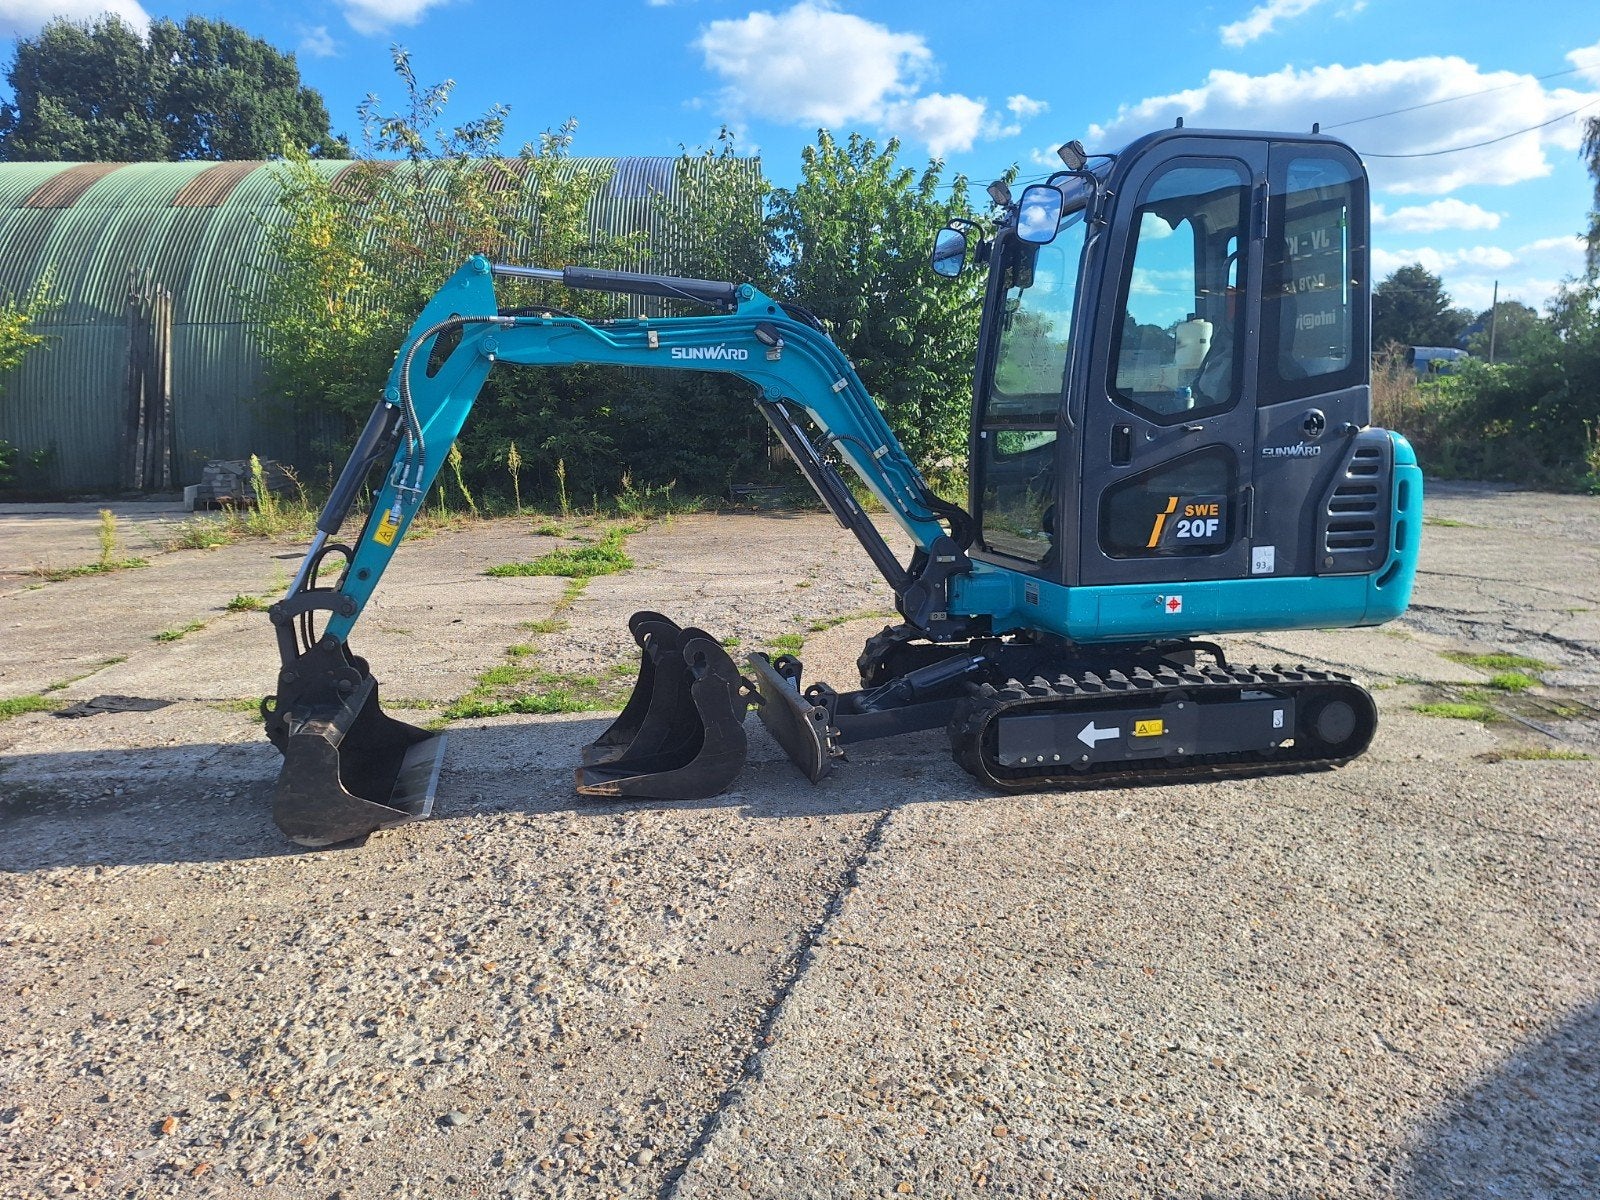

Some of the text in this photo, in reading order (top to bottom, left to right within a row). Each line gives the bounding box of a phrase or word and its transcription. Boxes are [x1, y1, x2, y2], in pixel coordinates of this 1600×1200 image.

[671, 342, 748, 361] SUNWARD
[1262, 441, 1321, 456] SUNWARD
[1184, 504, 1218, 517] SWE
[1176, 519, 1218, 538] 20F
[1255, 561, 1267, 570] 93
